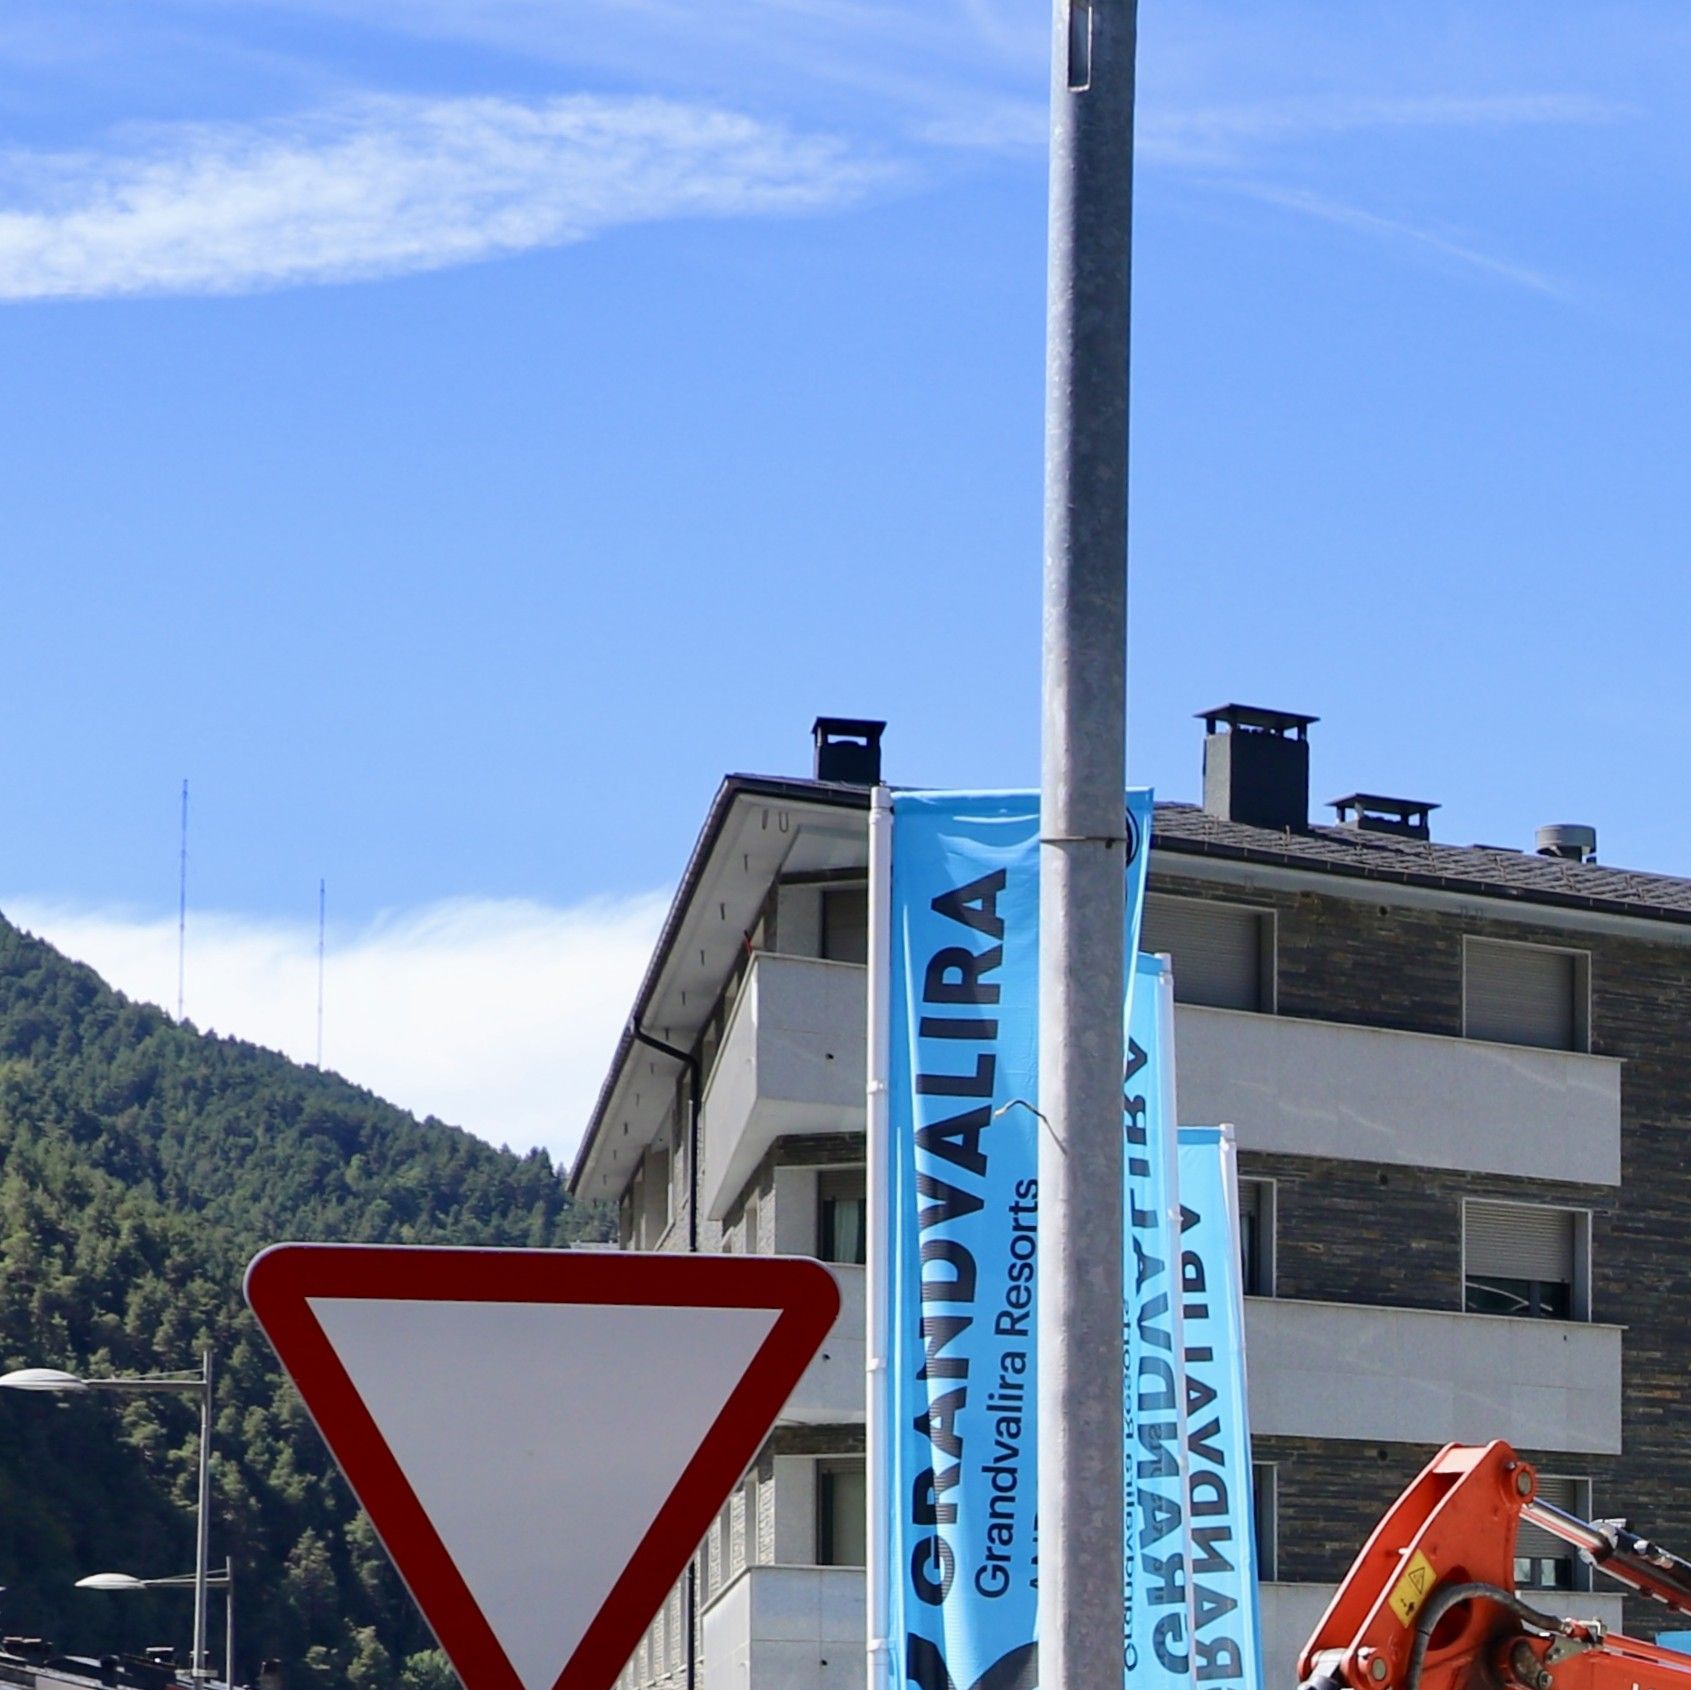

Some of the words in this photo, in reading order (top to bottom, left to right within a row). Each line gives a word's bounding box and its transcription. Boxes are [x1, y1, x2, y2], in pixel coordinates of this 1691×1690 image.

[911, 868, 1007, 1606] GRANDVALIRA
[995, 1178, 1039, 1337] Resorts
[975, 1351, 1028, 1599] Grandvalira
